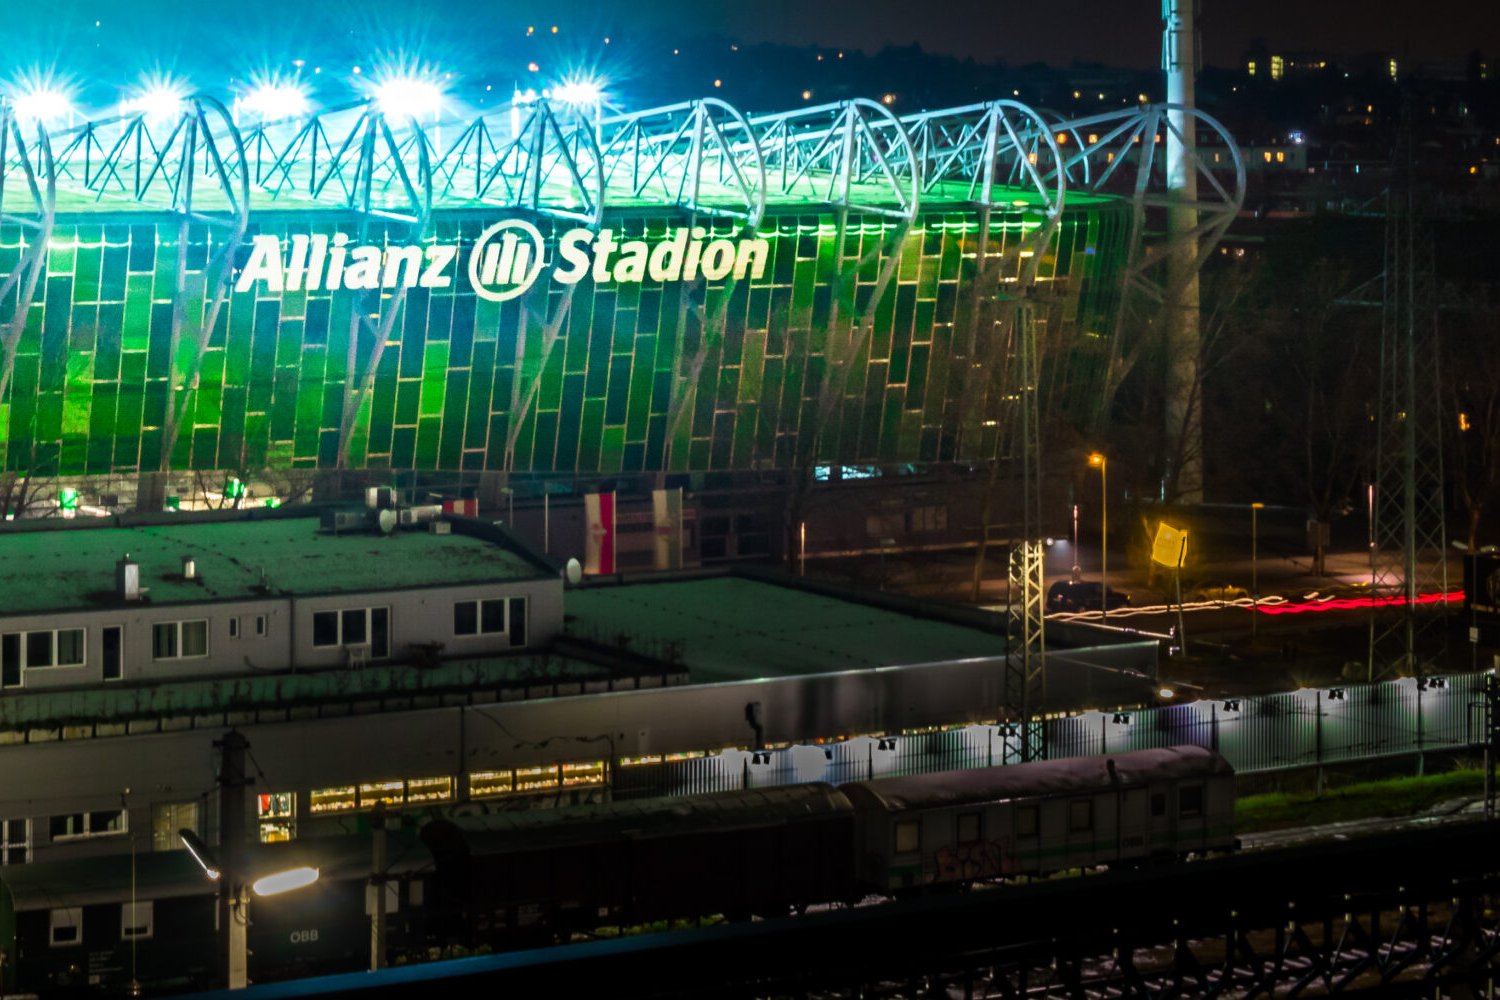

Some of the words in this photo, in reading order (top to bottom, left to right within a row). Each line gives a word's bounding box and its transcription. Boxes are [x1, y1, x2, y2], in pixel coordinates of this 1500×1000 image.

[236, 233, 456, 293] Allianz
[553, 227, 769, 284] Stadion
[290, 928, 319, 943] ÖBB
